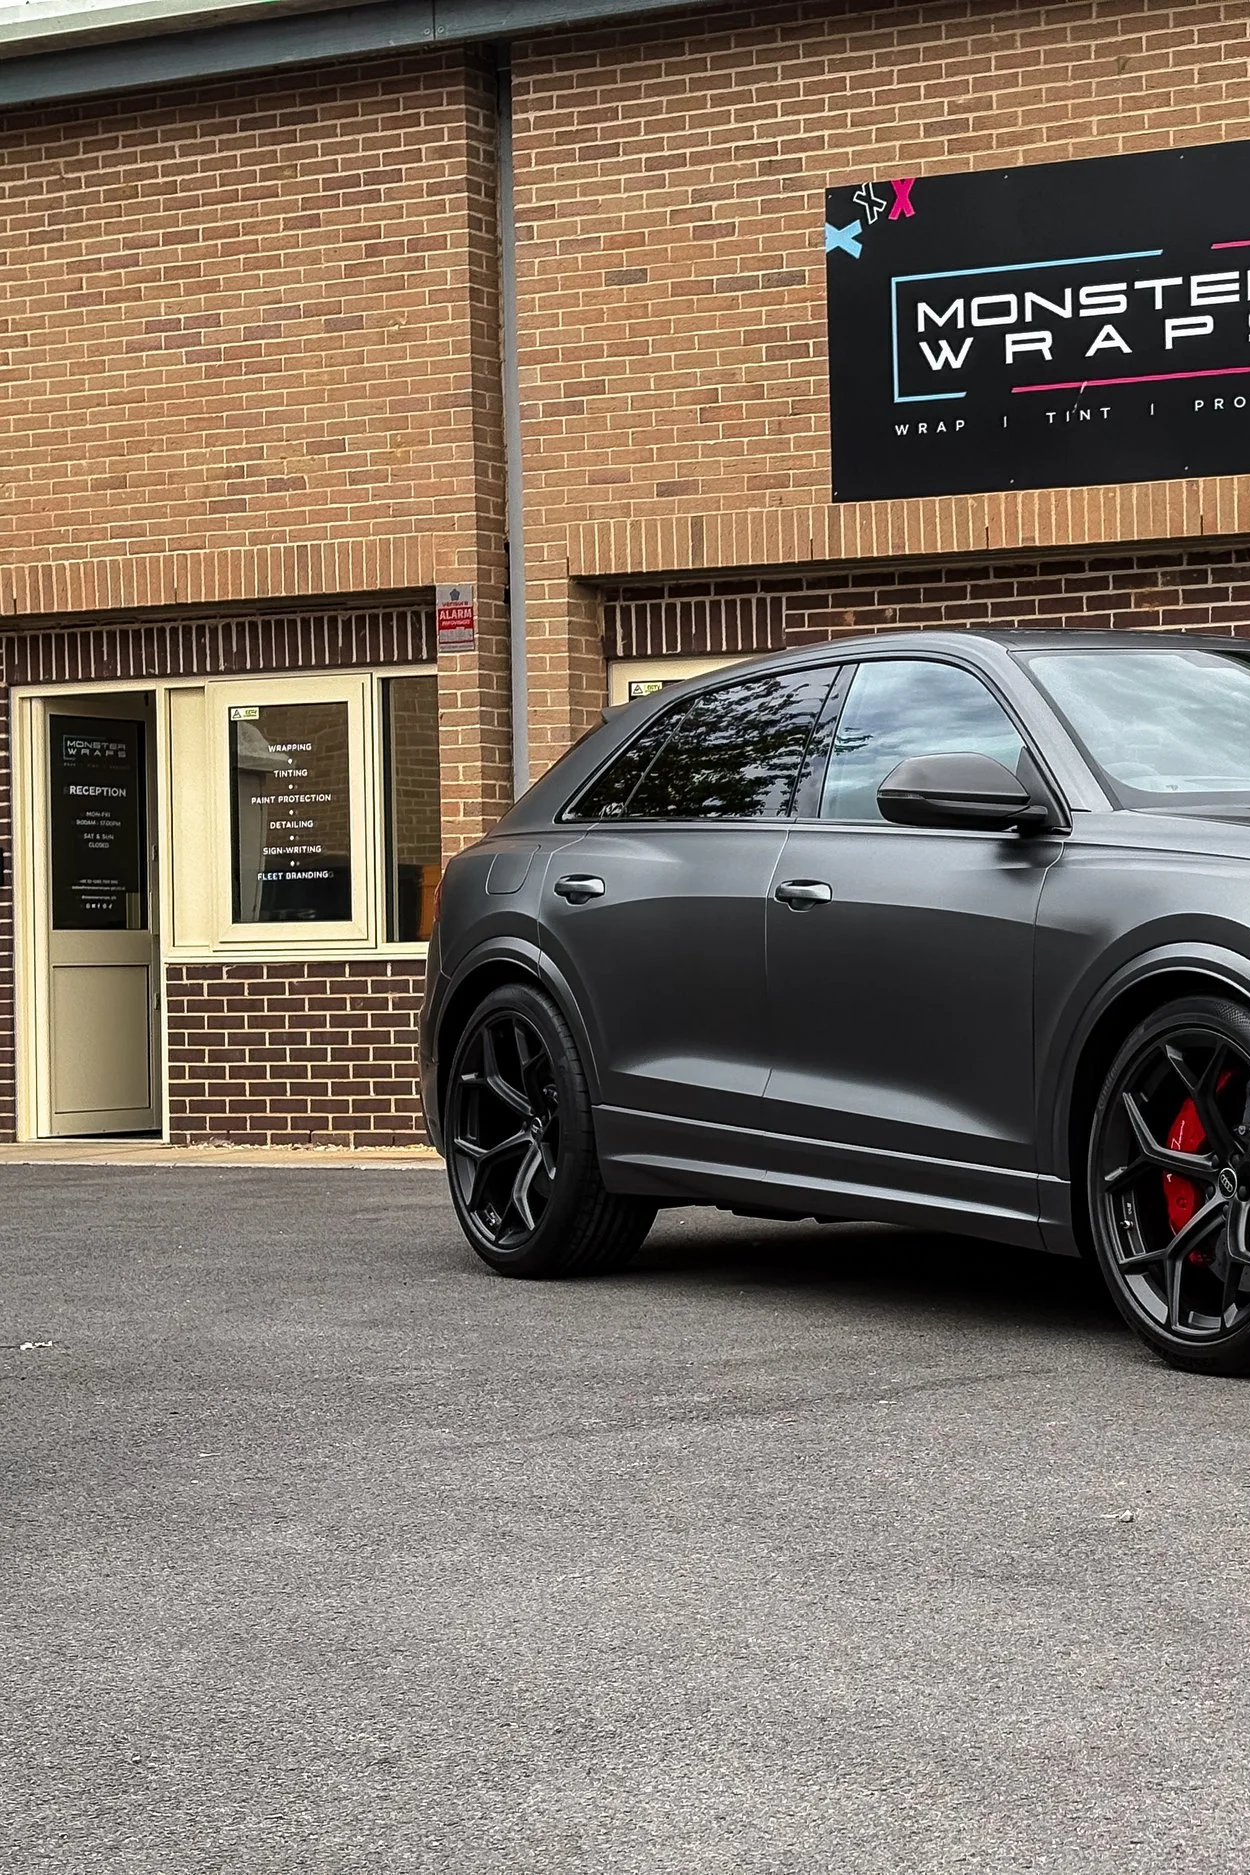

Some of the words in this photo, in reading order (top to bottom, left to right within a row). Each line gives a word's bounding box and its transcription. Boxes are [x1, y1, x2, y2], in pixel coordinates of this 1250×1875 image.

[895, 417, 966, 436] WRAP
[1046, 406, 1112, 424] TINT
[439, 608, 472, 620] ALARM
[66, 740, 126, 750] MONSTER
[268, 743, 312, 752] WRAPPING
[67, 748, 126, 758] WRAPS
[273, 769, 308, 777] TINTING
[69, 785, 127, 797] RECEPTION
[251, 796, 275, 804] PAINT
[278, 794, 331, 803] PROTECTION
[269, 820, 314, 829] DETAILING
[262, 845, 322, 855] SIGN-WRITING
[257, 872, 284, 881] FLEET
[286, 871, 329, 880] BRANDING
